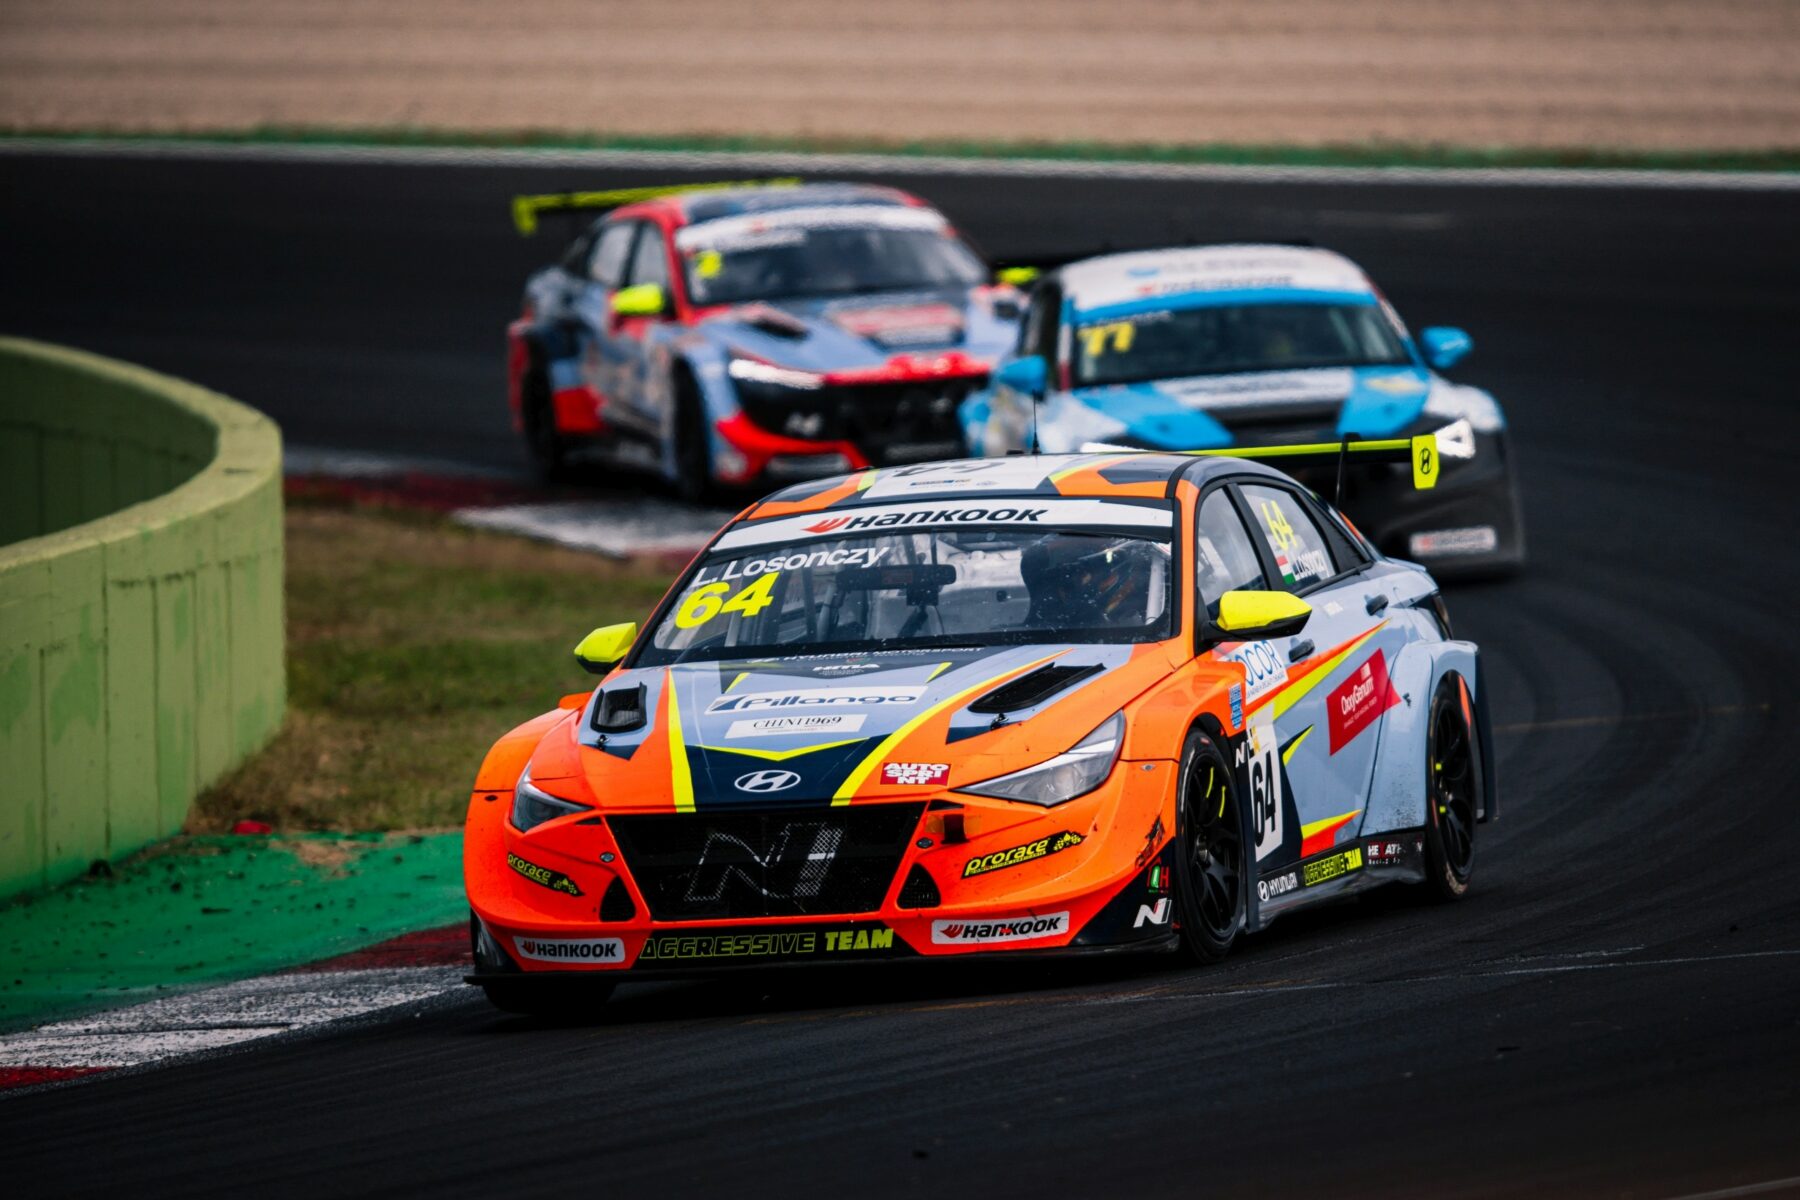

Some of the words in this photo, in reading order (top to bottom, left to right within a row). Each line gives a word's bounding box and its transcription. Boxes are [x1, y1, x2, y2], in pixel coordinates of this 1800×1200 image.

[1261, 501, 1297, 551] 64
[690, 567, 718, 588] L.
[674, 571, 780, 629] 64
[741, 694, 918, 709] Pillango
[883, 763, 950, 771] AUTO
[886, 769, 943, 778] SPRI
[1252, 750, 1276, 847] 64
[508, 854, 551, 880] prorace
[964, 839, 1048, 876] prorace
[1268, 872, 1299, 896] HYUNDAI
[639, 932, 816, 959] AGGRESSIVE
[825, 928, 894, 951] TEAM
